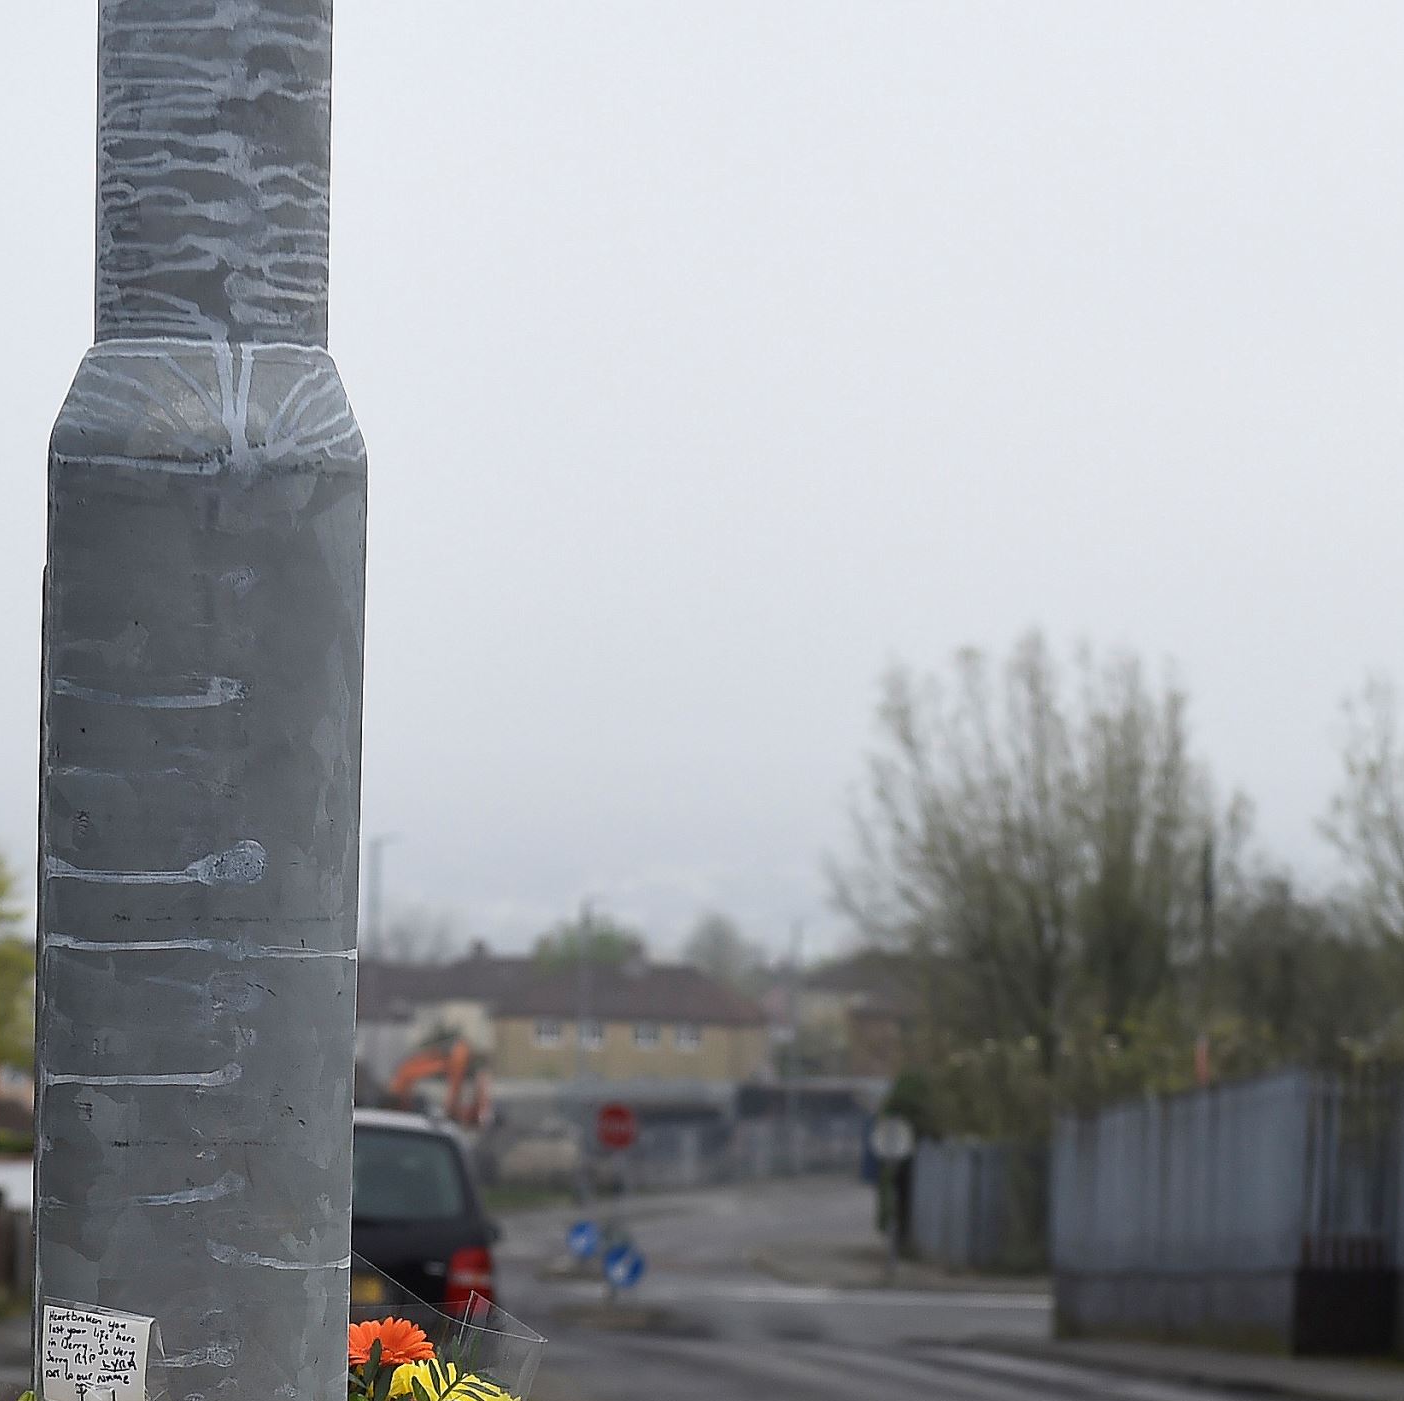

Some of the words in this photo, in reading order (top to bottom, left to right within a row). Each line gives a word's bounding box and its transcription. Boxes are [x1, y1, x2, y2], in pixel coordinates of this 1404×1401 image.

[49, 1311, 102, 1324] Heartbroken
[108, 1321, 126, 1333] you
[67, 1328, 87, 1340] your
[94, 1328, 109, 1343] life
[116, 1332, 136, 1343] here
[48, 1338, 56, 1346] in
[98, 1344, 108, 1355] So
[102, 1359, 137, 1372] LYRA
[77, 1372, 93, 1381] our
